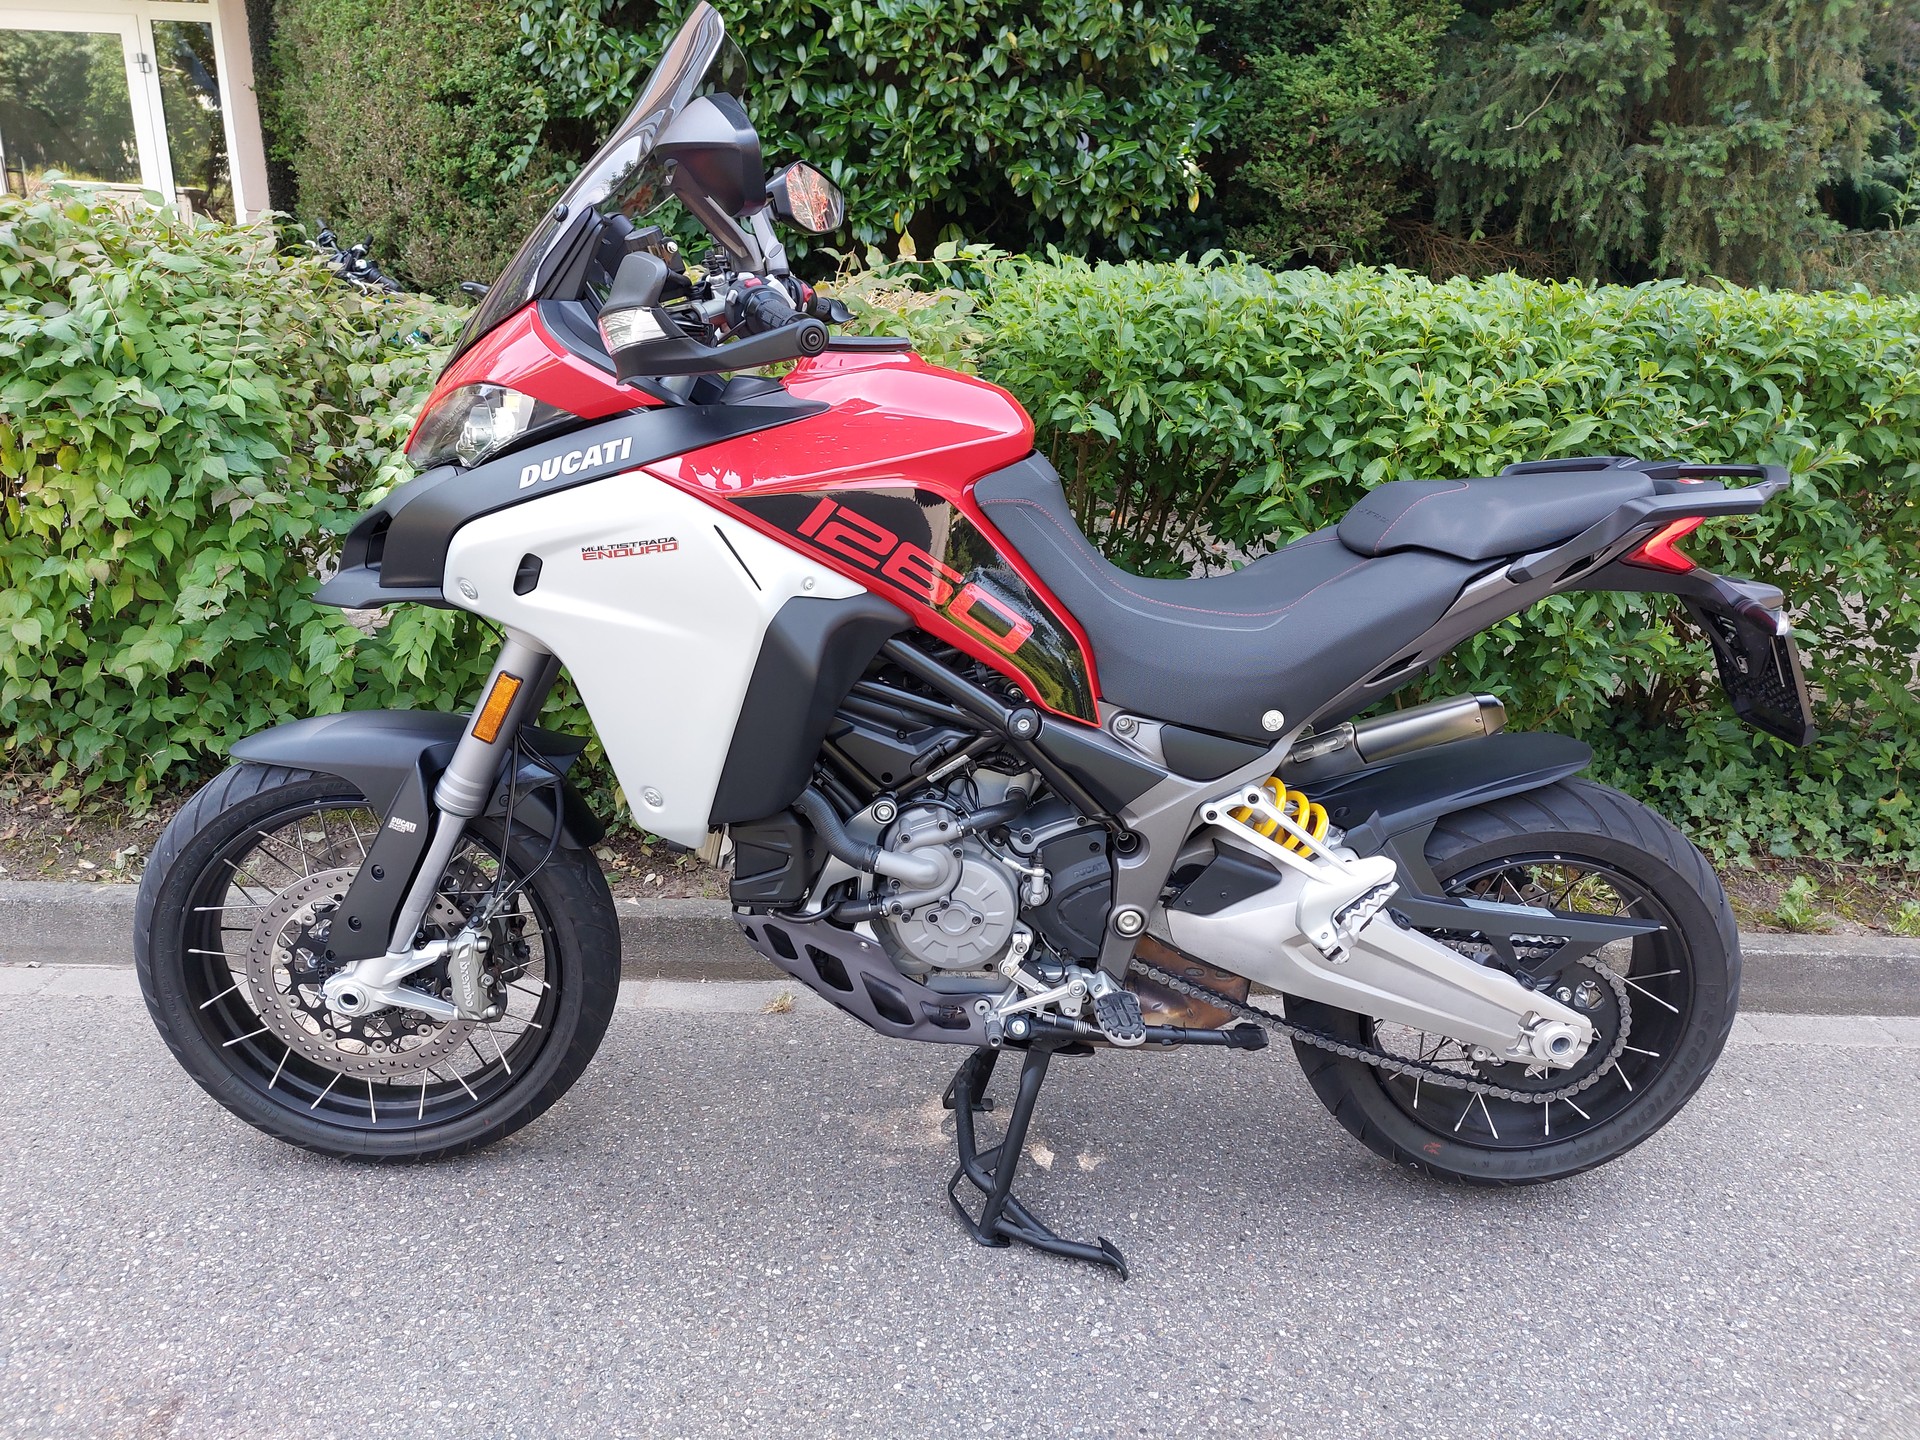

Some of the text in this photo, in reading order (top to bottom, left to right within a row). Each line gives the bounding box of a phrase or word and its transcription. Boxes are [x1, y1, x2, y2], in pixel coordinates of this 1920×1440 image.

[518, 436, 633, 490] DUCATI
[581, 536, 677, 553] MULTISTRADA
[582, 542, 679, 561] ENDURO
[796, 496, 1034, 654] 1260
[391, 816, 417, 831] DUCATI
[459, 961, 474, 1008] brembo
